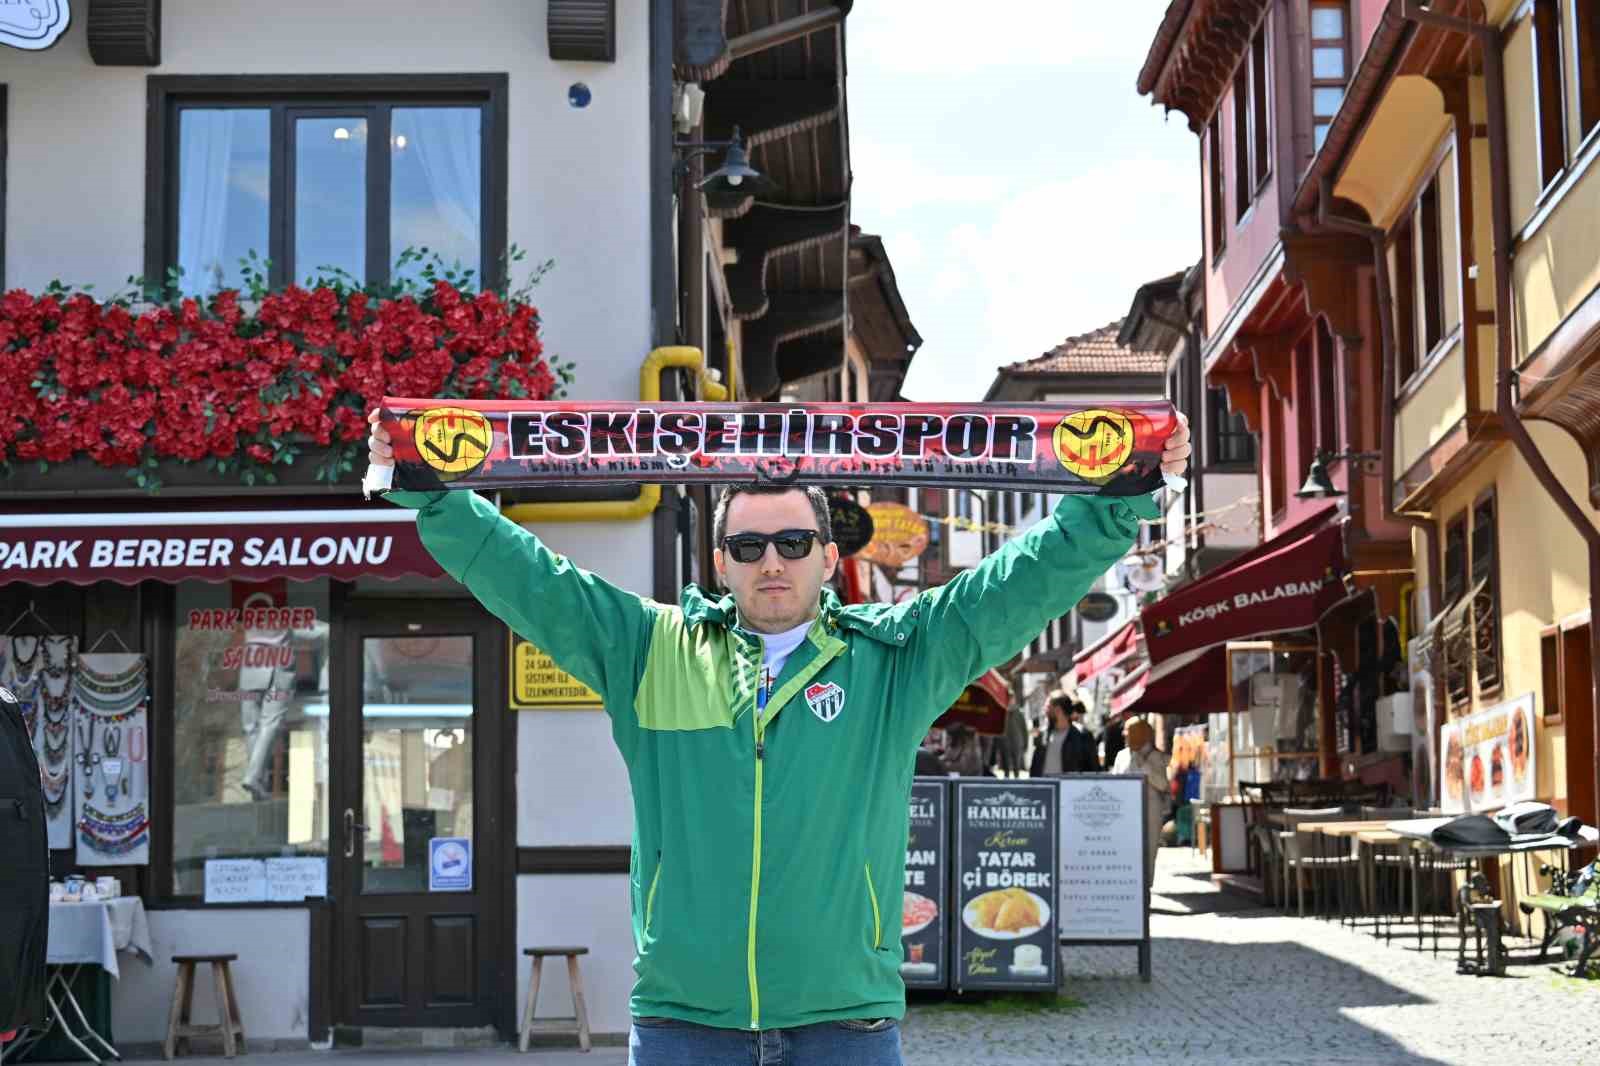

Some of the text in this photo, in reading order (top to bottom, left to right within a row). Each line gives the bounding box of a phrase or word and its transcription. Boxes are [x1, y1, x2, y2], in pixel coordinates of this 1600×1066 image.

[508, 408, 1037, 468] ESKİŞEHİRSPOR
[89, 538, 234, 567] BERBER
[240, 535, 393, 565] SALONU
[189, 606, 317, 631] PARK BERBER
[223, 645, 293, 669] SALONU
[977, 851, 1037, 868] TATAR
[985, 868, 1051, 888] BÖREK
